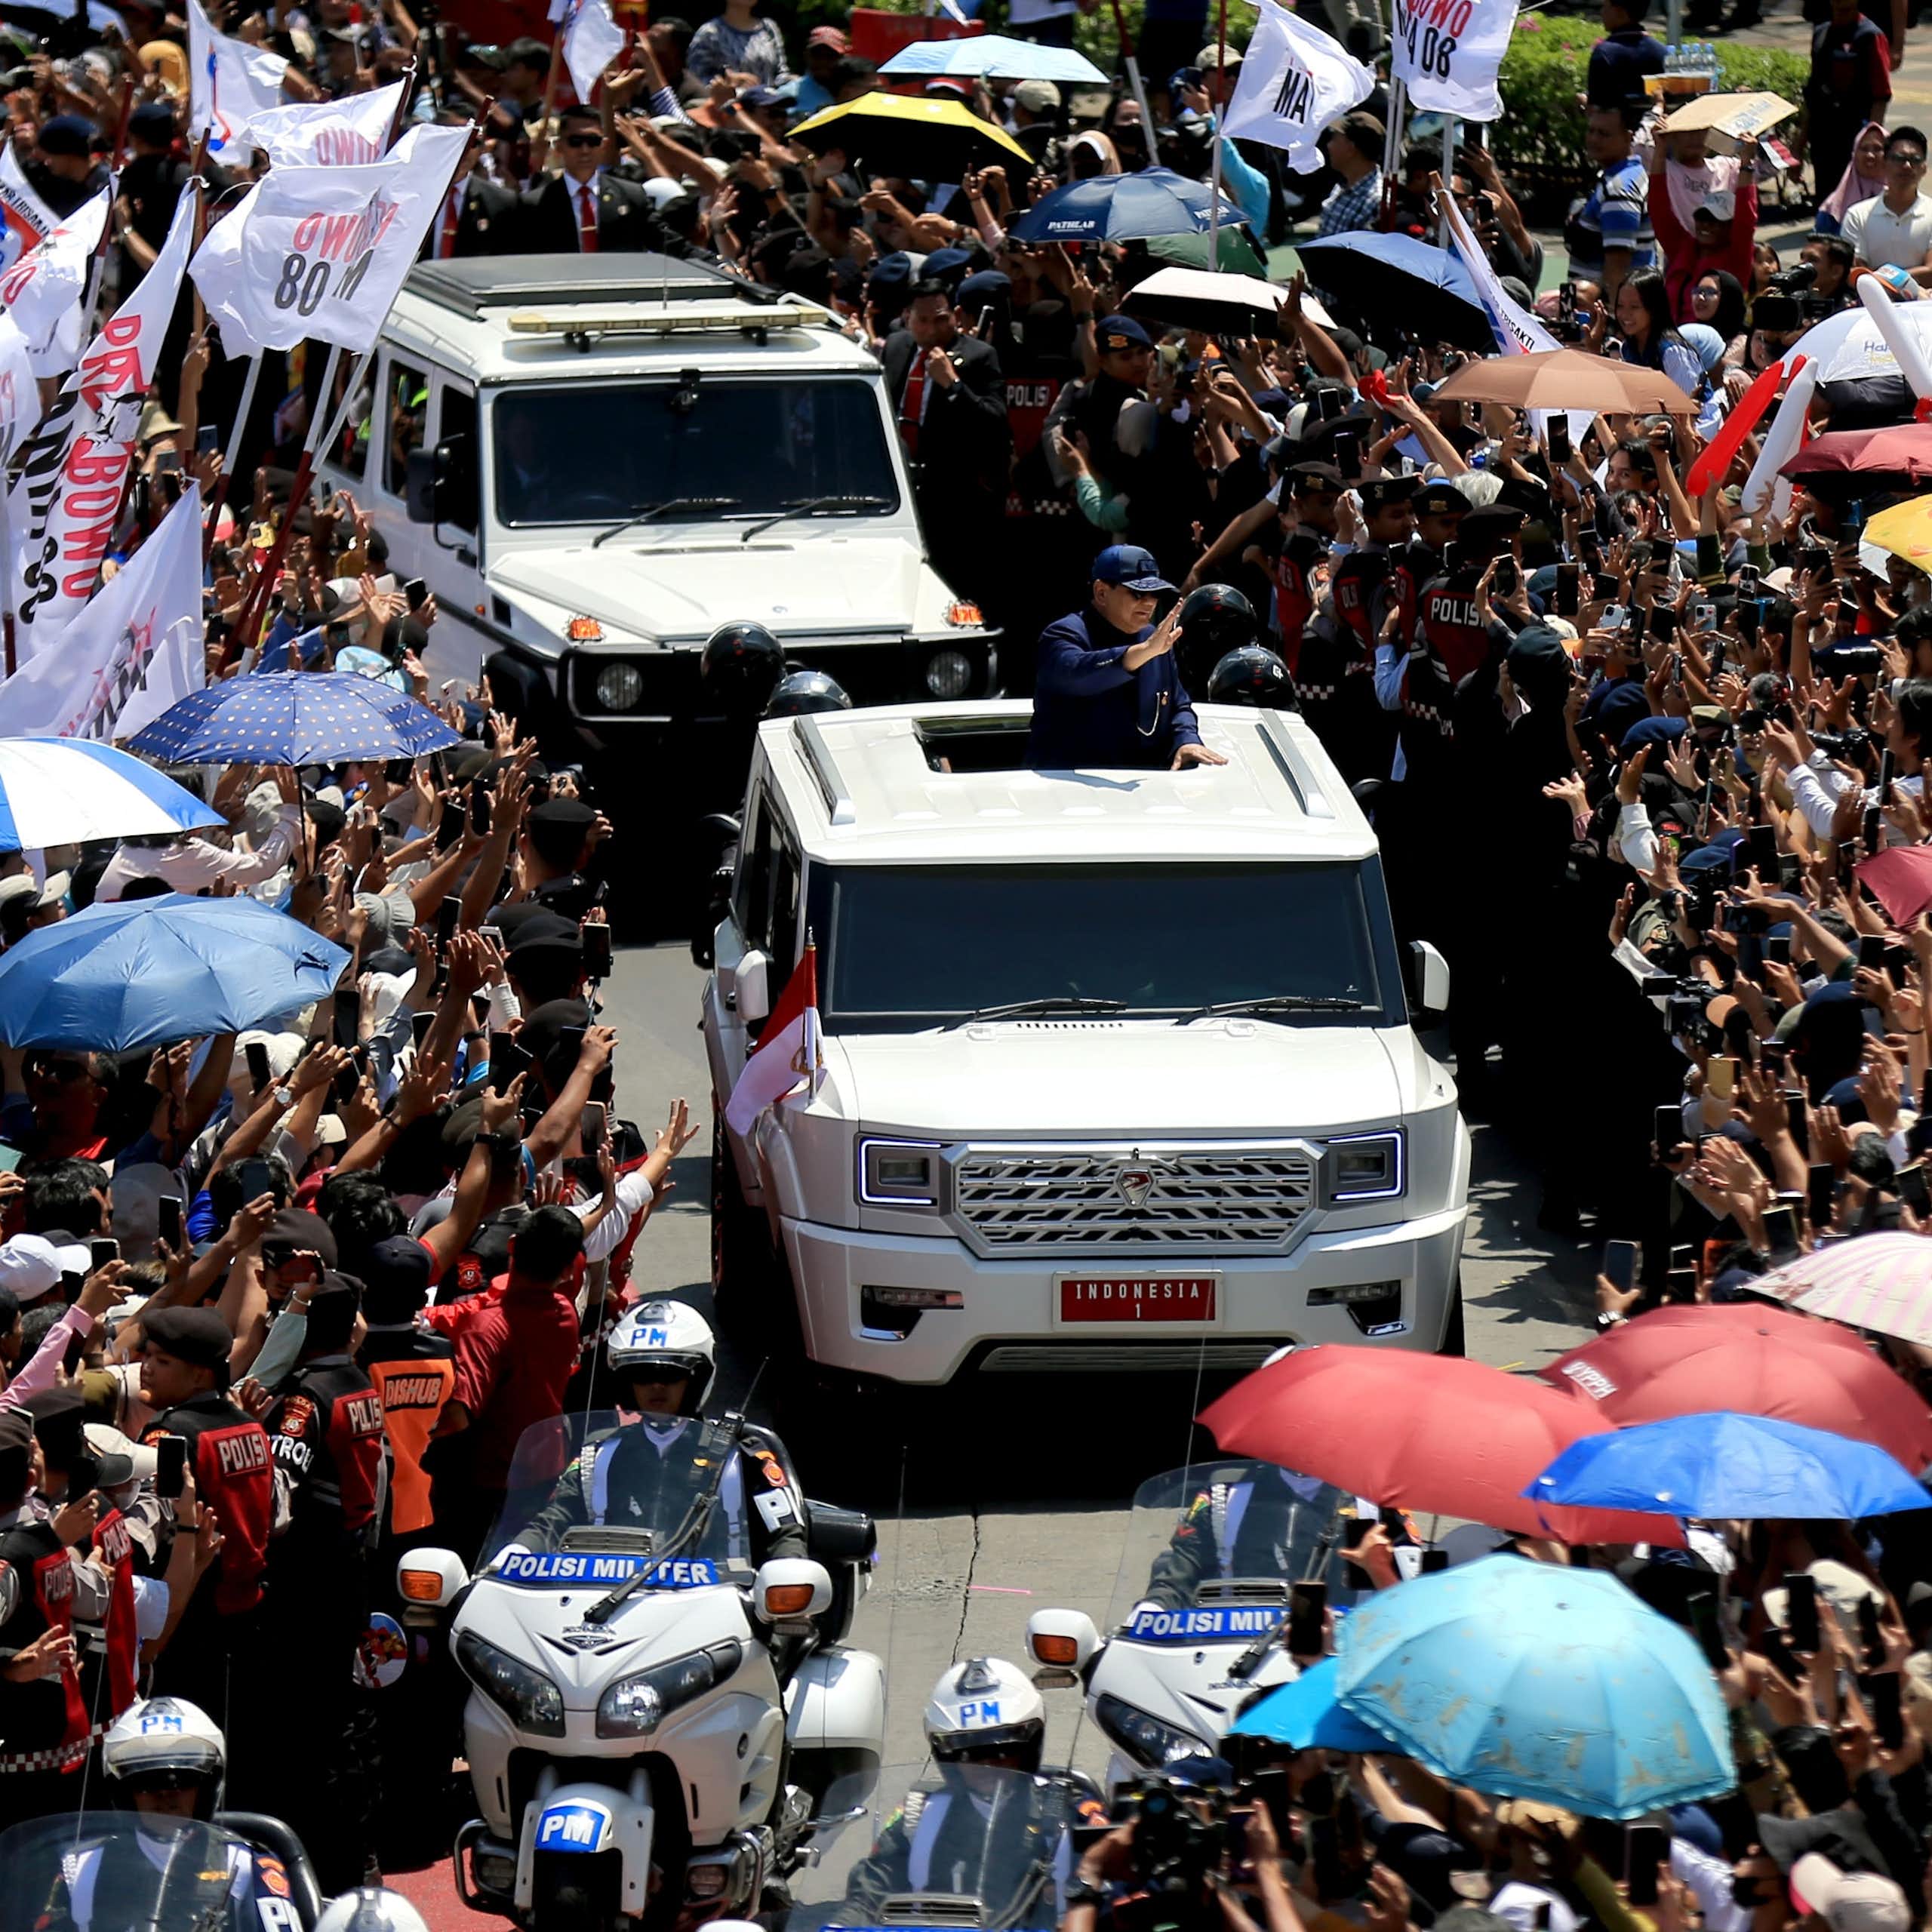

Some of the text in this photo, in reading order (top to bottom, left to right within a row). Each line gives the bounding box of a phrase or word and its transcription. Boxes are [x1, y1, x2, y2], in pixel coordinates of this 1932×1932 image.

[1422, 26, 1457, 78] 08
[1075, 1282, 1200, 1300] INDONESIA
[1135, 1303, 1141, 1318] 1
[630, 1327, 668, 1348] PM
[385, 1377, 442, 1407] DISHUB
[220, 1436, 269, 1474] POLISI
[503, 1555, 712, 1584] POLISI MILTER
[1136, 1612, 1223, 1635] POLISI
[141, 1715, 183, 1734] PM
[959, 1701, 1001, 1728] PM
[541, 1814, 596, 1845] PM
